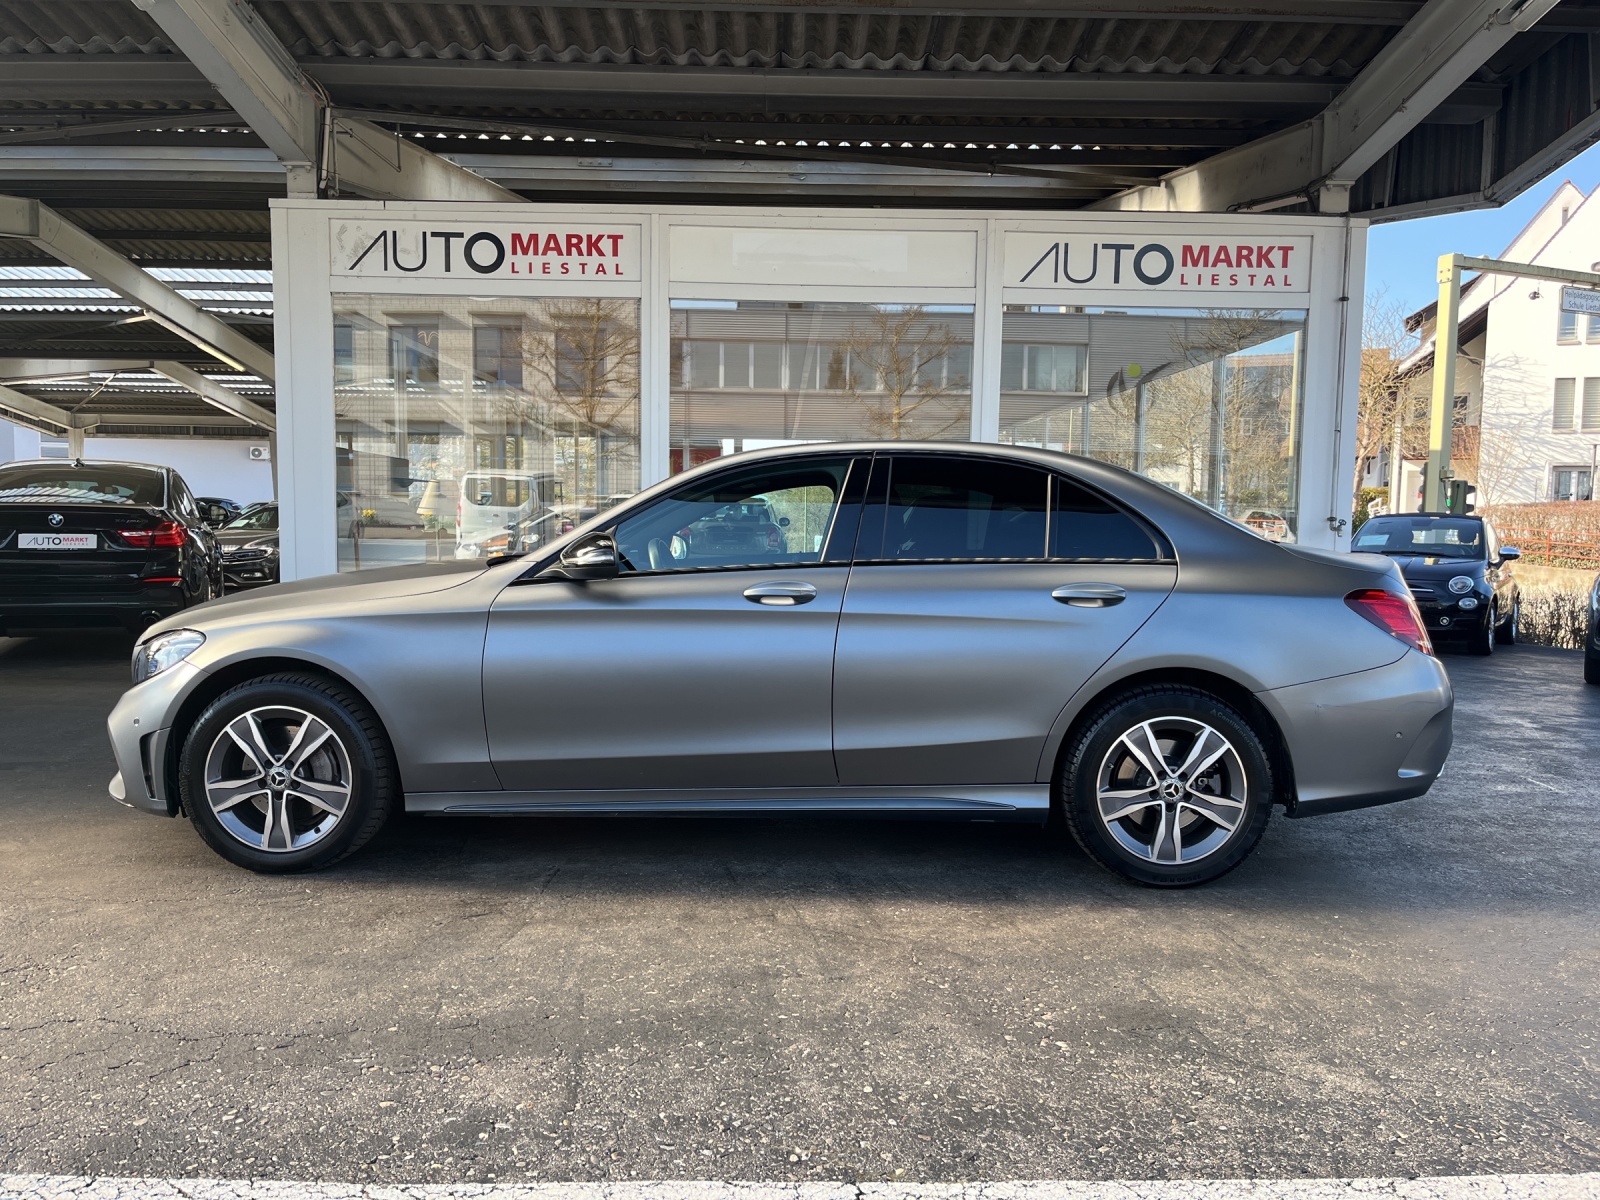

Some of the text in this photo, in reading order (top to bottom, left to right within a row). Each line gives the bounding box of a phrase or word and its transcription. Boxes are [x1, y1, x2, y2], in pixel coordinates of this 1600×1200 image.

[348, 230, 624, 274] AUTO MARKT
[511, 262, 624, 275] LIESTAL
[1019, 242, 1295, 285] AUTO MARKT
[1180, 274, 1292, 287] LIESTAL
[27, 537, 62, 546] AUTO
